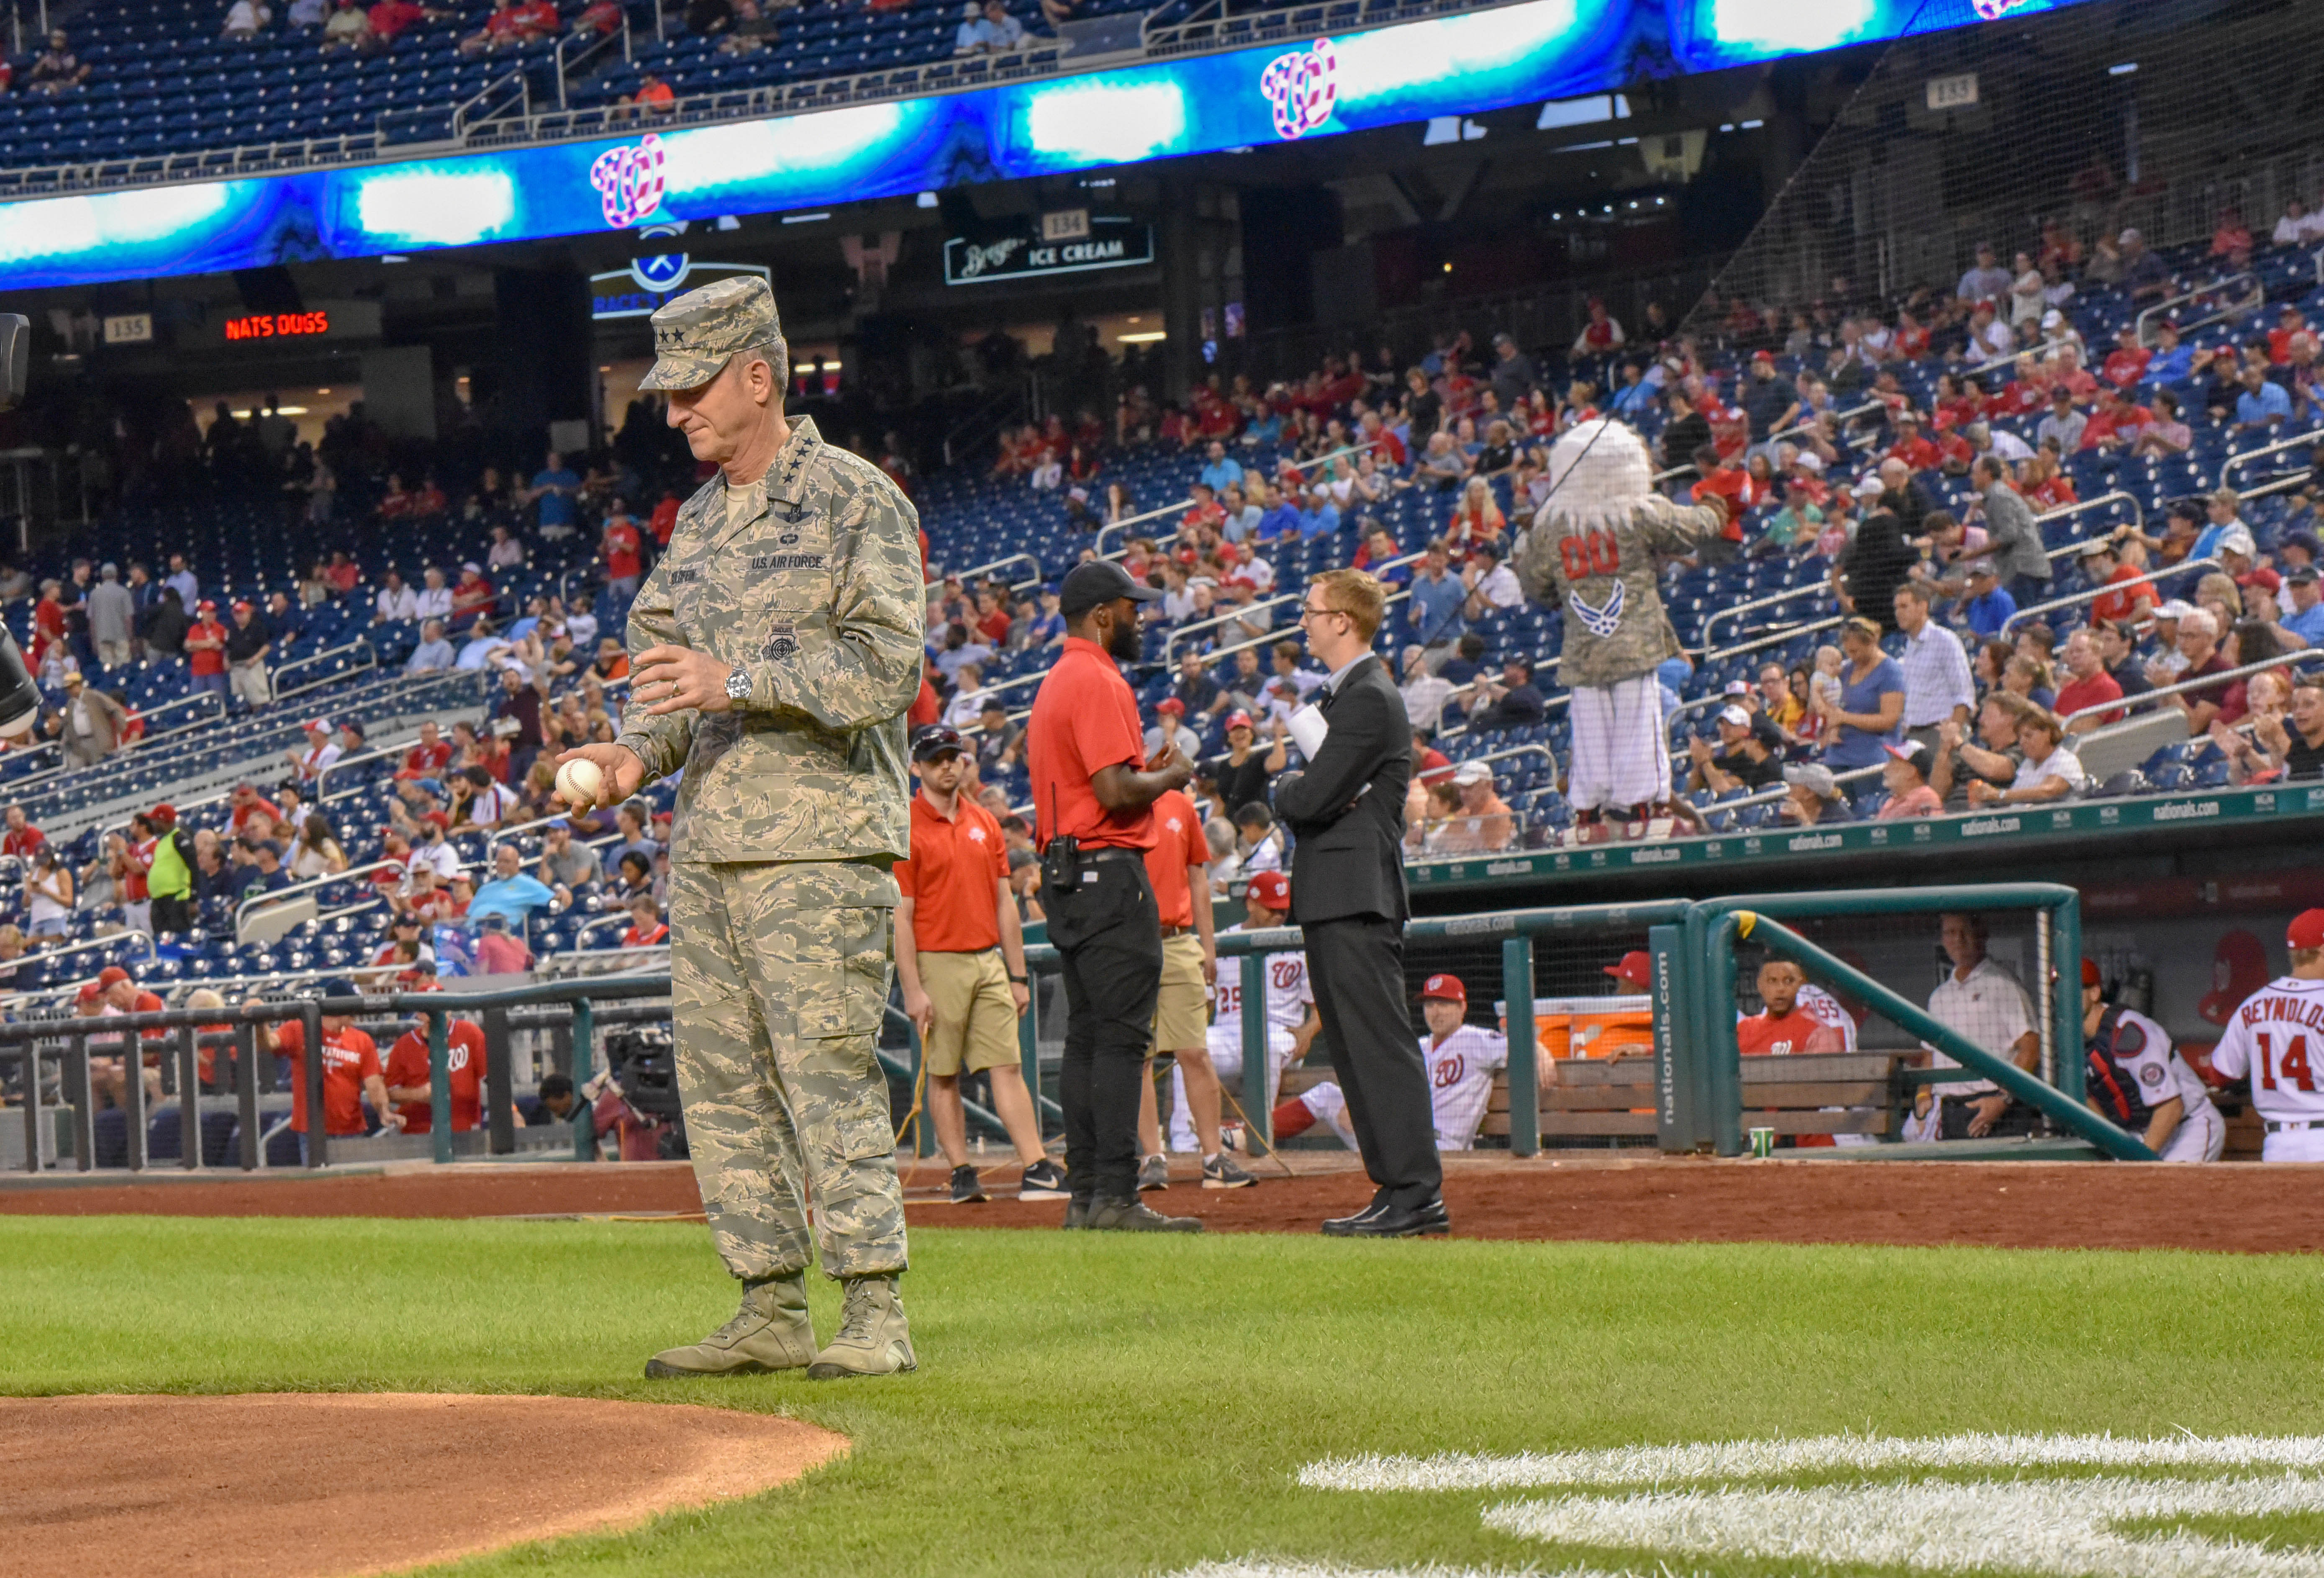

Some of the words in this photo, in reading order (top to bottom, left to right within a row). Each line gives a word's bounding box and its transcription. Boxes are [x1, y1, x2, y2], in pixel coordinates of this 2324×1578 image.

[1029, 247, 1057, 266] ICE
[1062, 240, 1124, 263] CREAM
[114, 319, 144, 338] 135
[226, 315, 274, 340] NATS
[752, 558, 767, 569] U.S.
[769, 556, 787, 568] AIR
[788, 555, 823, 568] FORCE
[1560, 529, 1621, 581] 00
[2154, 800, 2219, 820] nationals.com
[1961, 816, 2020, 836] nationals.com
[1658, 951, 1673, 1125] nationals.com
[2257, 1033, 2315, 1091] 14
